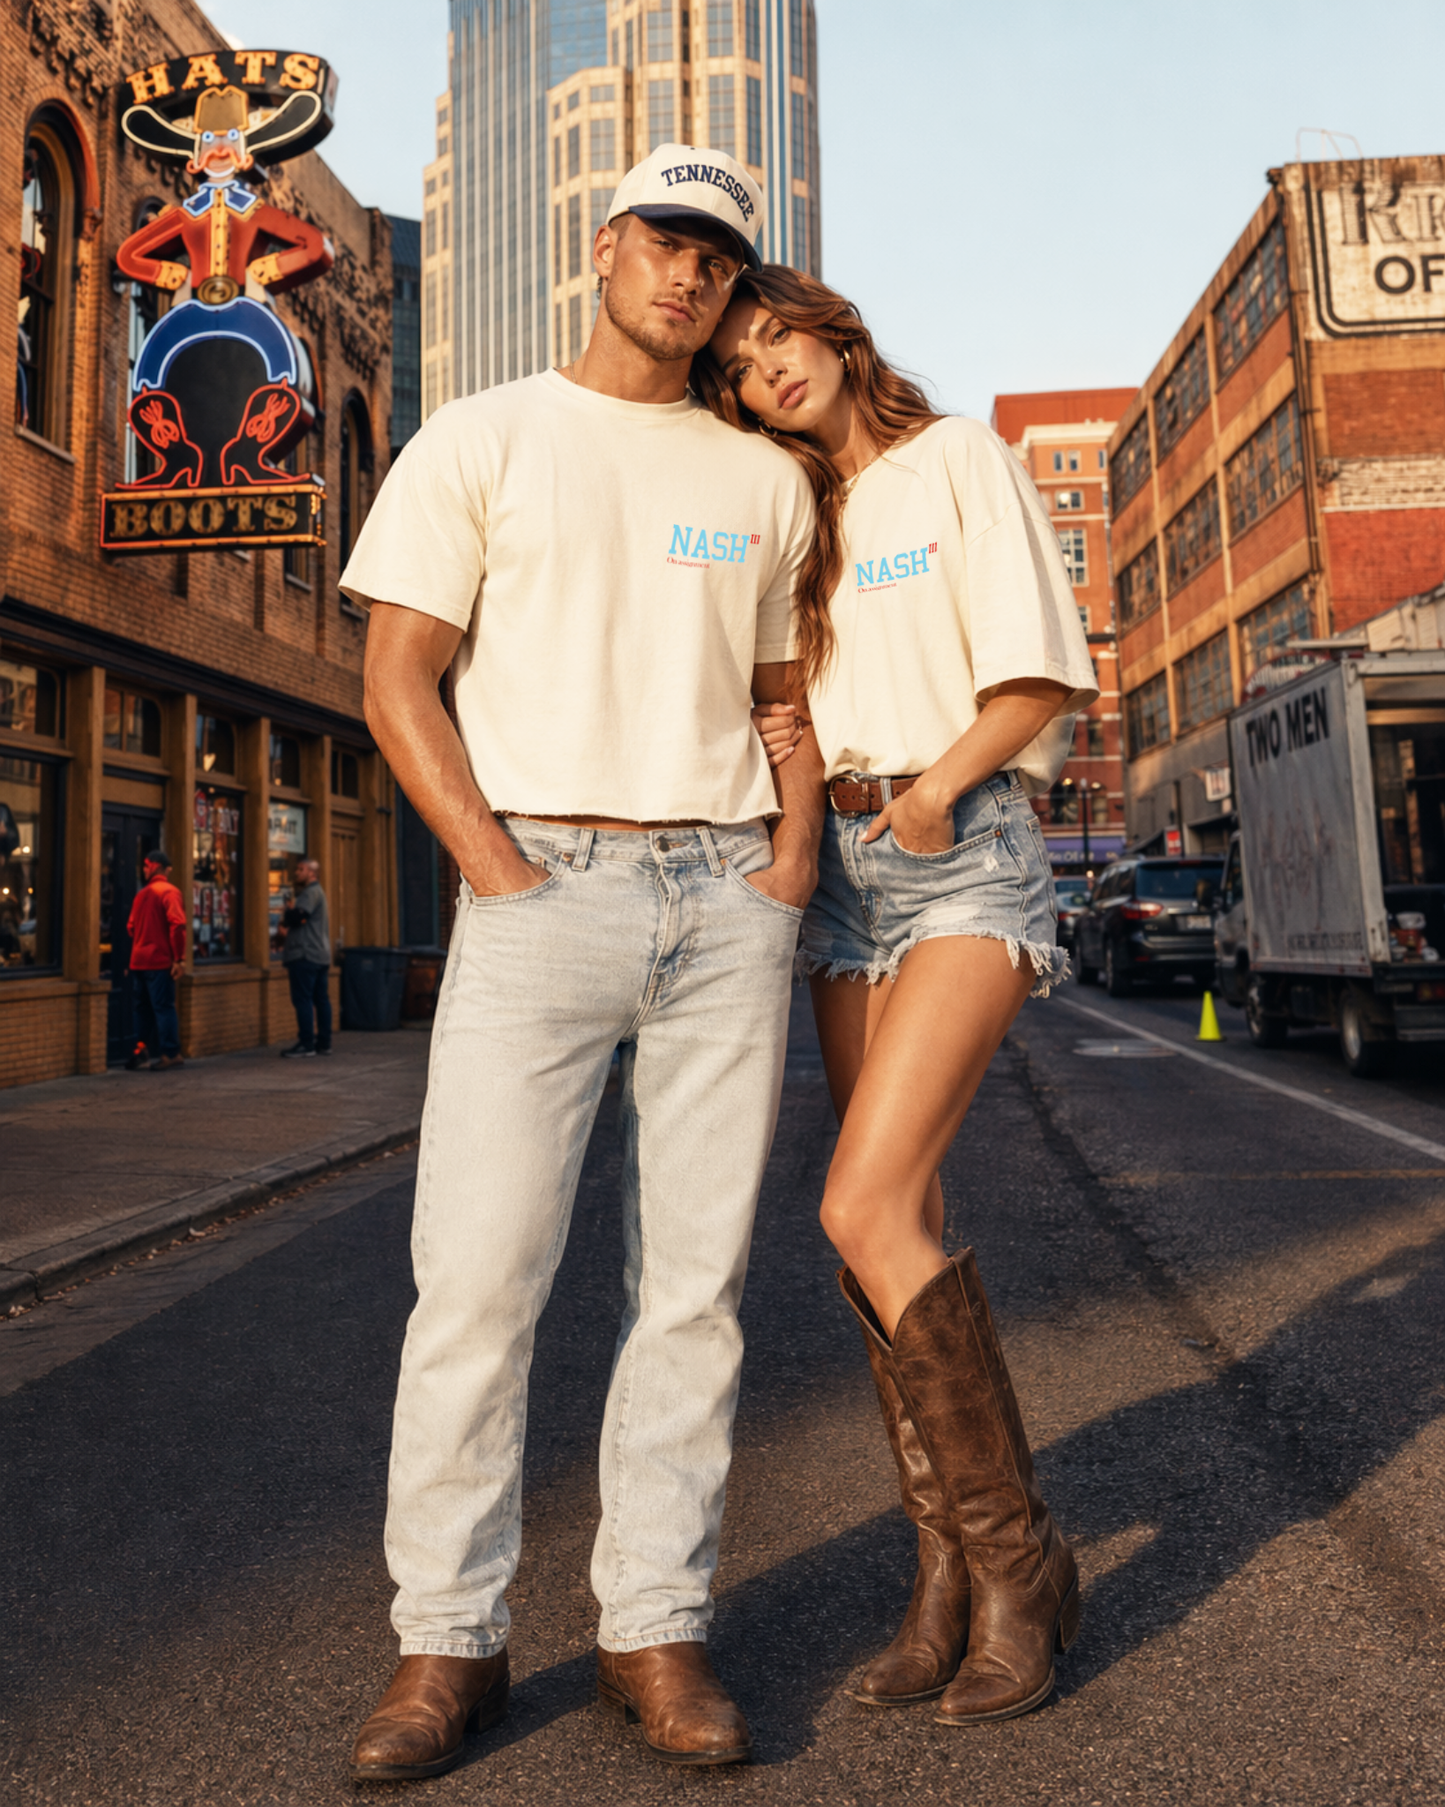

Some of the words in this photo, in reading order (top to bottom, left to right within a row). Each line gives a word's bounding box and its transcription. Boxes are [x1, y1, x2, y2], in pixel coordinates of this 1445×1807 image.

[126, 51, 320, 105] HATS
[661, 164, 754, 222] TENNESSEE
[109, 495, 298, 538] BOOTS
[668, 524, 750, 563] NASH
[855, 547, 930, 587] NASH
[1246, 708, 1281, 767] TWO
[1285, 686, 1330, 753] MEN
